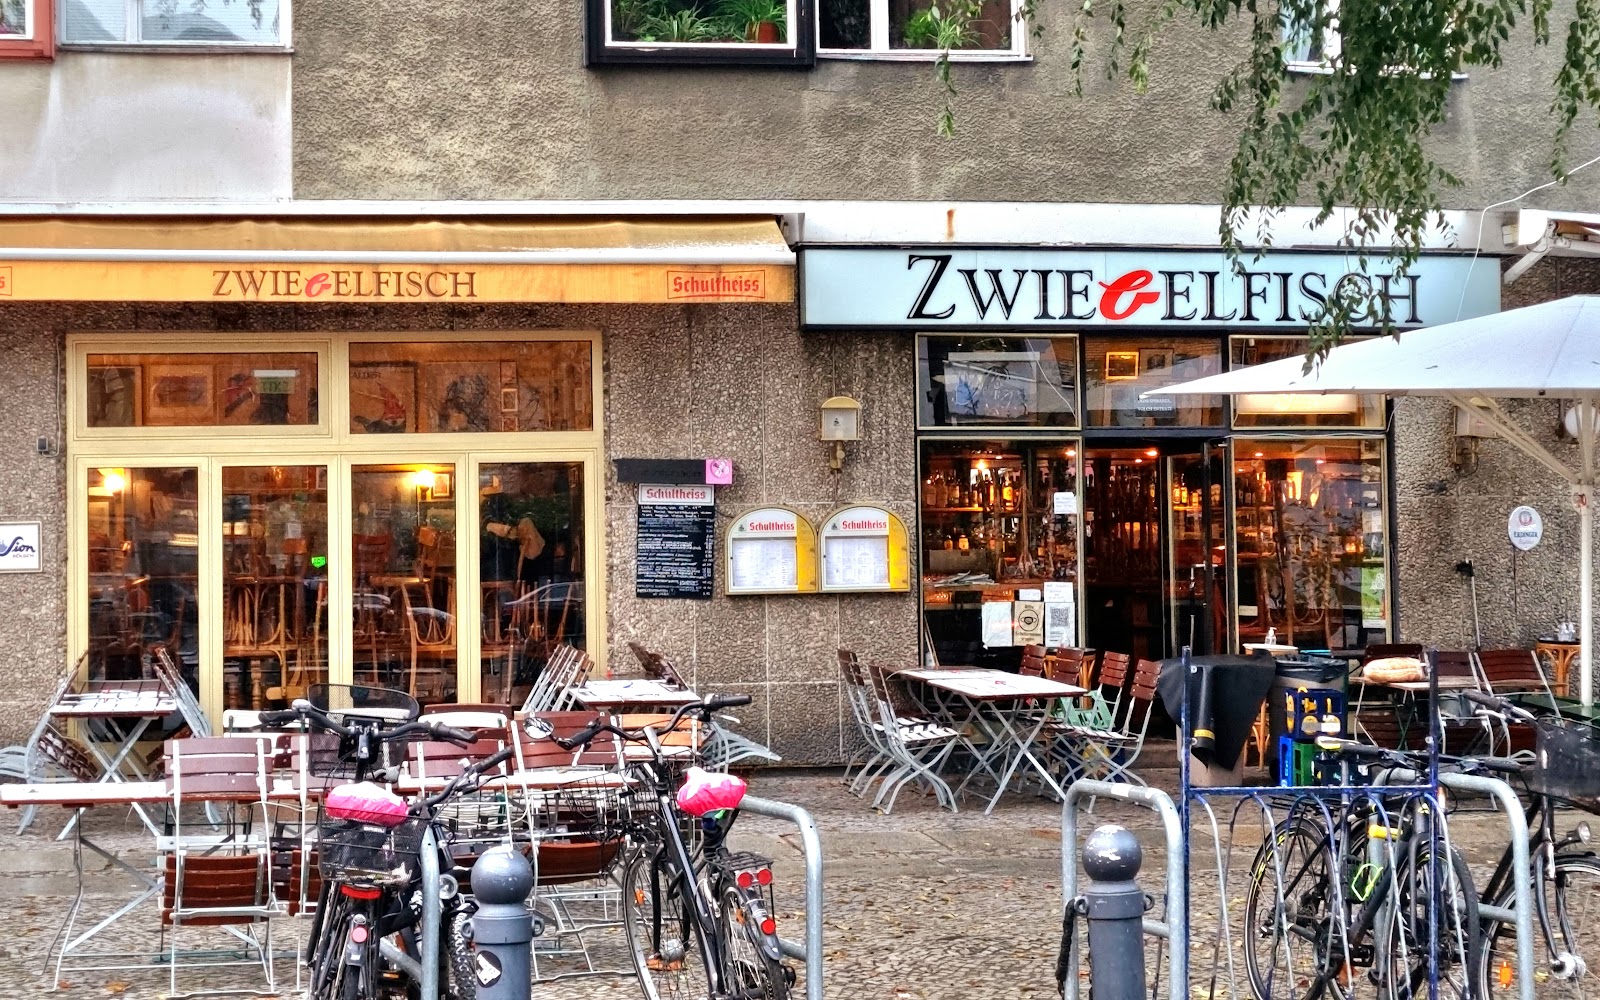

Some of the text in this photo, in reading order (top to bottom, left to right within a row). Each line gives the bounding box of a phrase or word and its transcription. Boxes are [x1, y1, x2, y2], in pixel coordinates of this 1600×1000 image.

[673, 275, 760, 293] Schultheiss
[646, 488, 706, 500] Schultheiss
[749, 520, 795, 532] Schultheiss
[842, 520, 887, 531] Schultheiss
